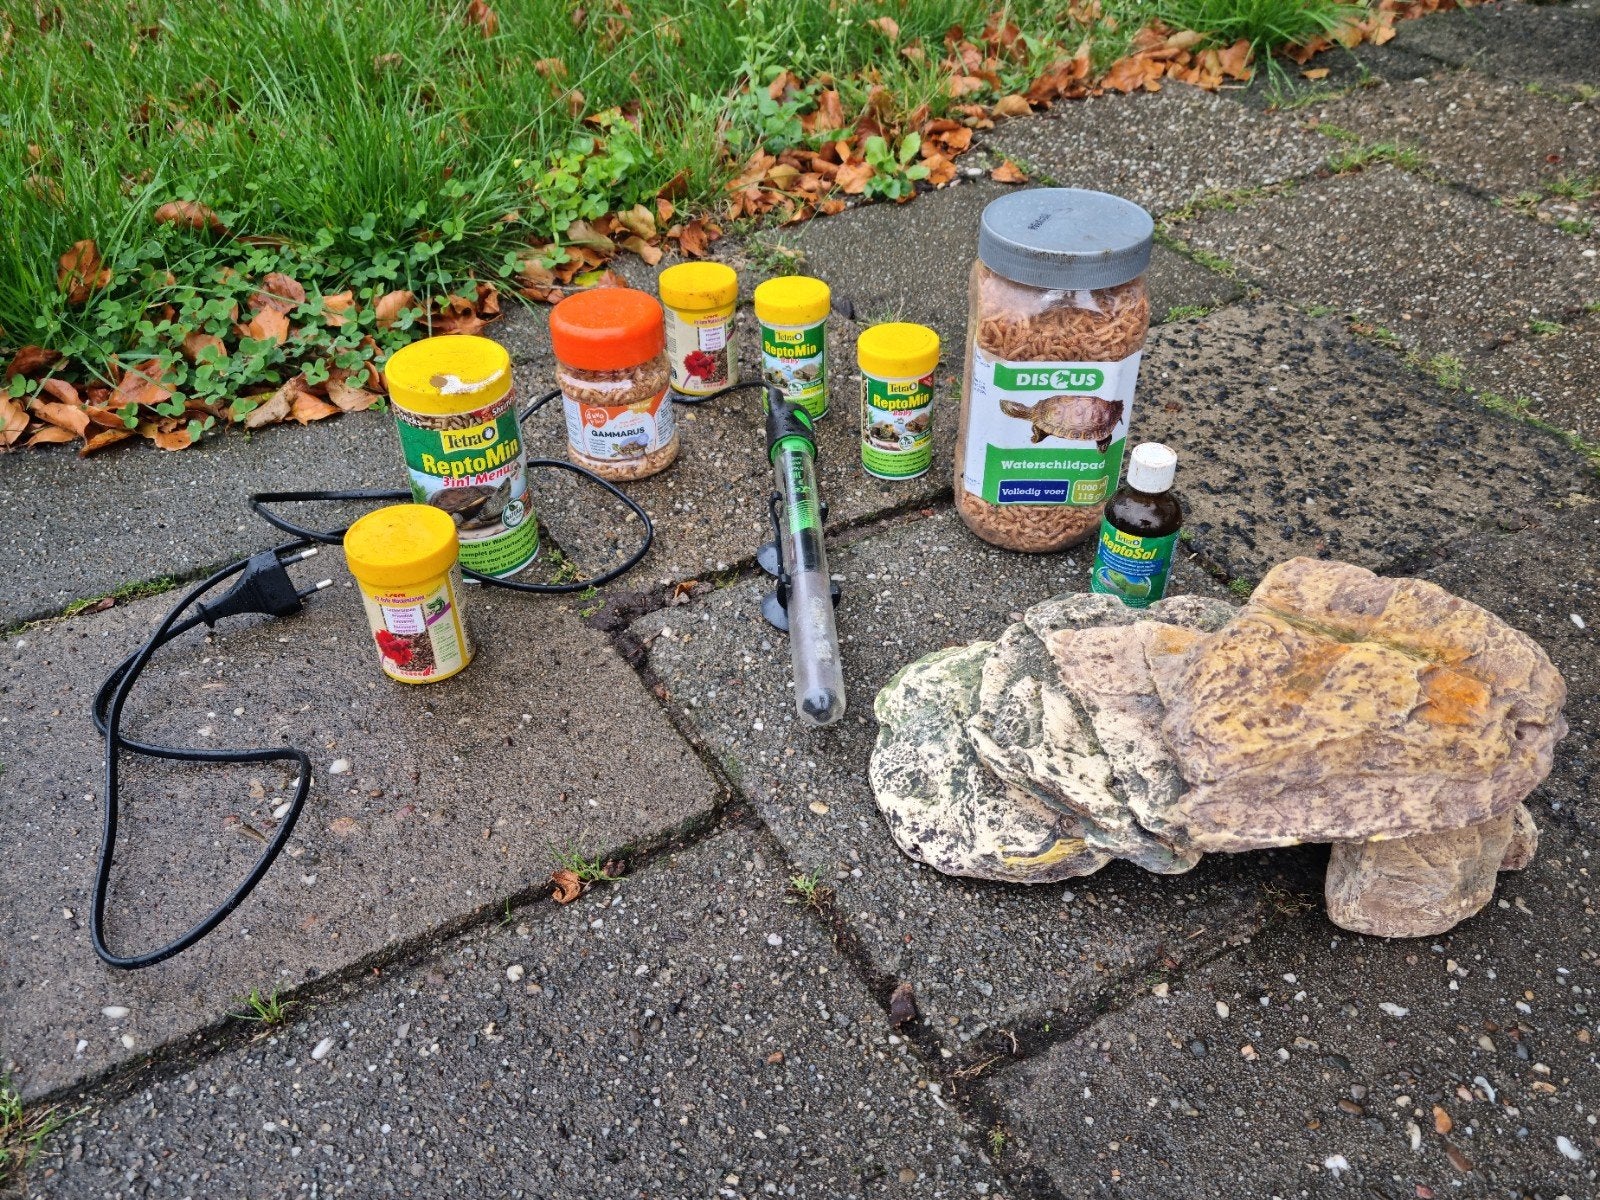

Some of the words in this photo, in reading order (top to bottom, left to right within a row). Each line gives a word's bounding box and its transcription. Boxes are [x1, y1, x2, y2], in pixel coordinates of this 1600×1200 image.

[764, 340, 817, 359] ReptoMin
[889, 383, 911, 393] Tetra
[1016, 370, 1097, 389] DISCUS
[873, 393, 930, 412] ReptoMin
[444, 432, 486, 449] Tetra
[591, 426, 646, 438] GAMMARUS
[421, 438, 519, 480] ReptoMin
[1001, 459, 1105, 472] Waterschildpad
[443, 476, 471, 487] 3in1
[474, 467, 512, 485] Menu
[1001, 486, 1042, 497] Volledig
[1044, 488, 1065, 496] voer
[1102, 531, 1158, 560] ReptoSol
